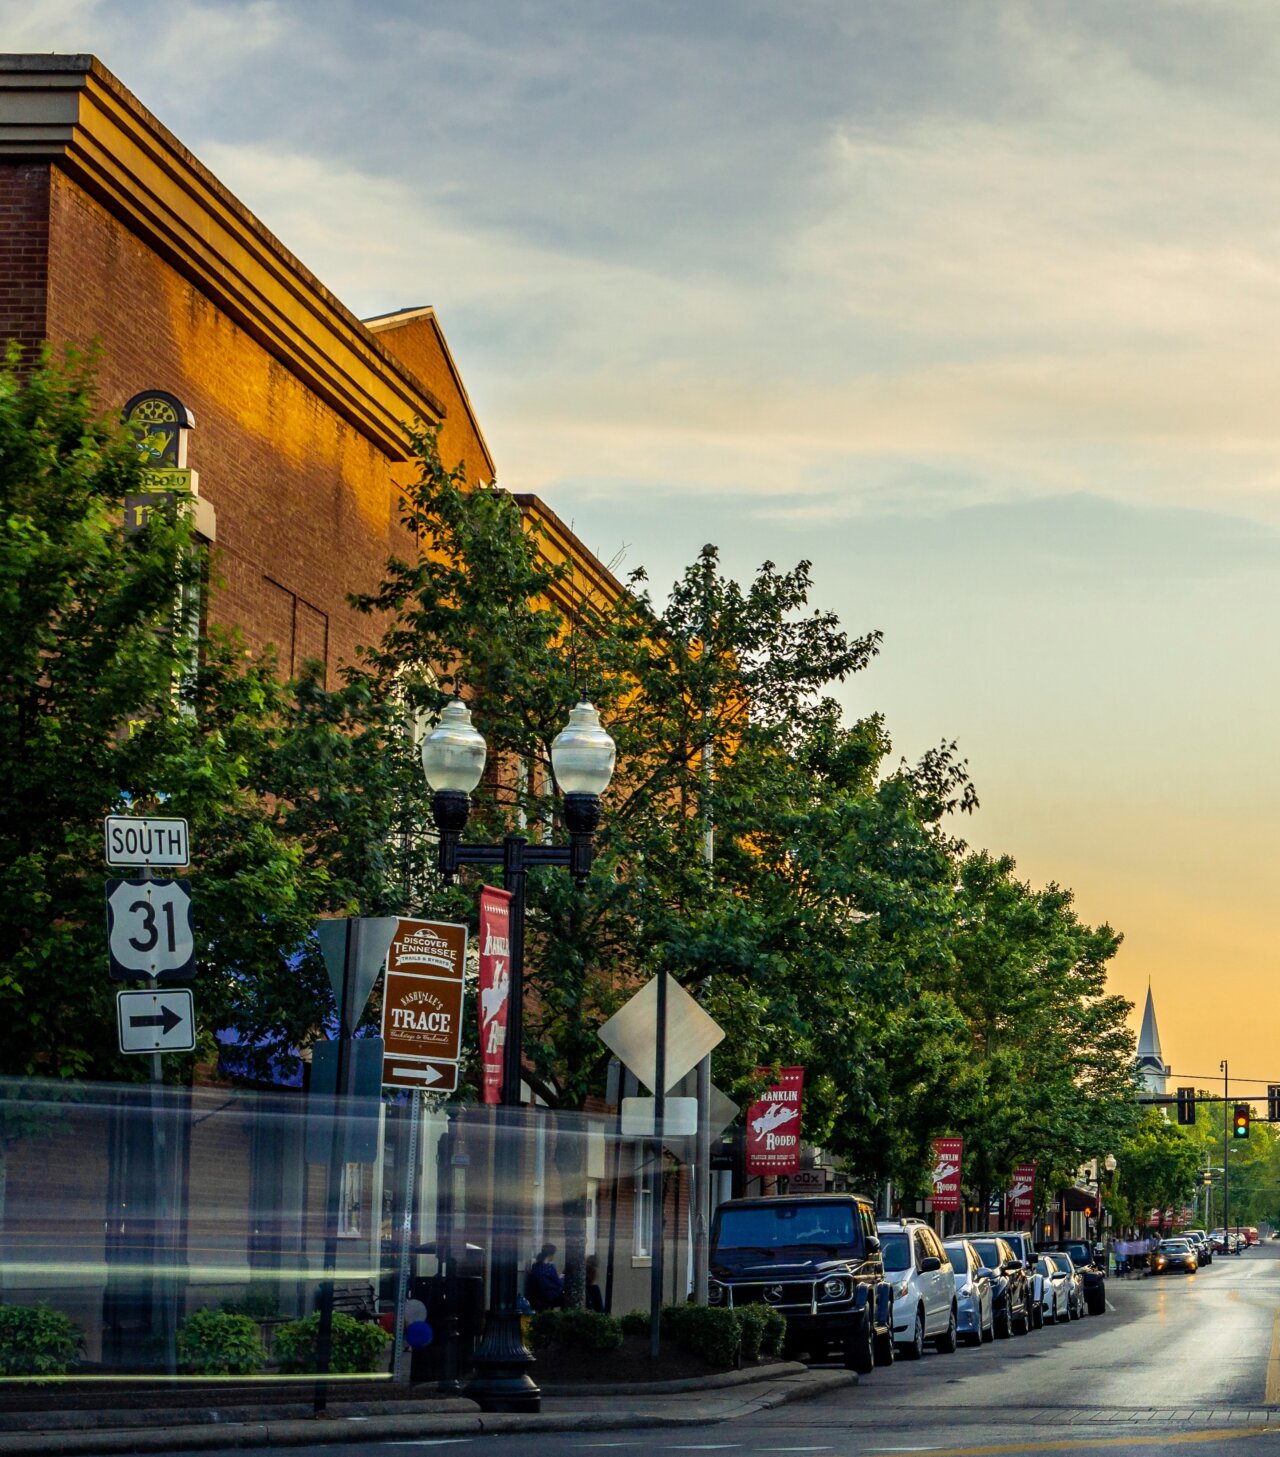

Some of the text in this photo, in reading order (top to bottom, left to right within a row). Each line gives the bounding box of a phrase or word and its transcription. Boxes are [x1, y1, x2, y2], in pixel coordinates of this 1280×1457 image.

[112, 827, 182, 855] SOUTH
[128, 900, 176, 953] 31
[393, 941, 457, 960] TENNESSEE
[403, 936, 448, 949] DISCOVER
[400, 991, 443, 1011] NASHVILLE'S
[391, 1008, 451, 1033] TRACE
[758, 1091, 798, 1101] RANKLIN
[766, 1133, 797, 1150] RODEO
